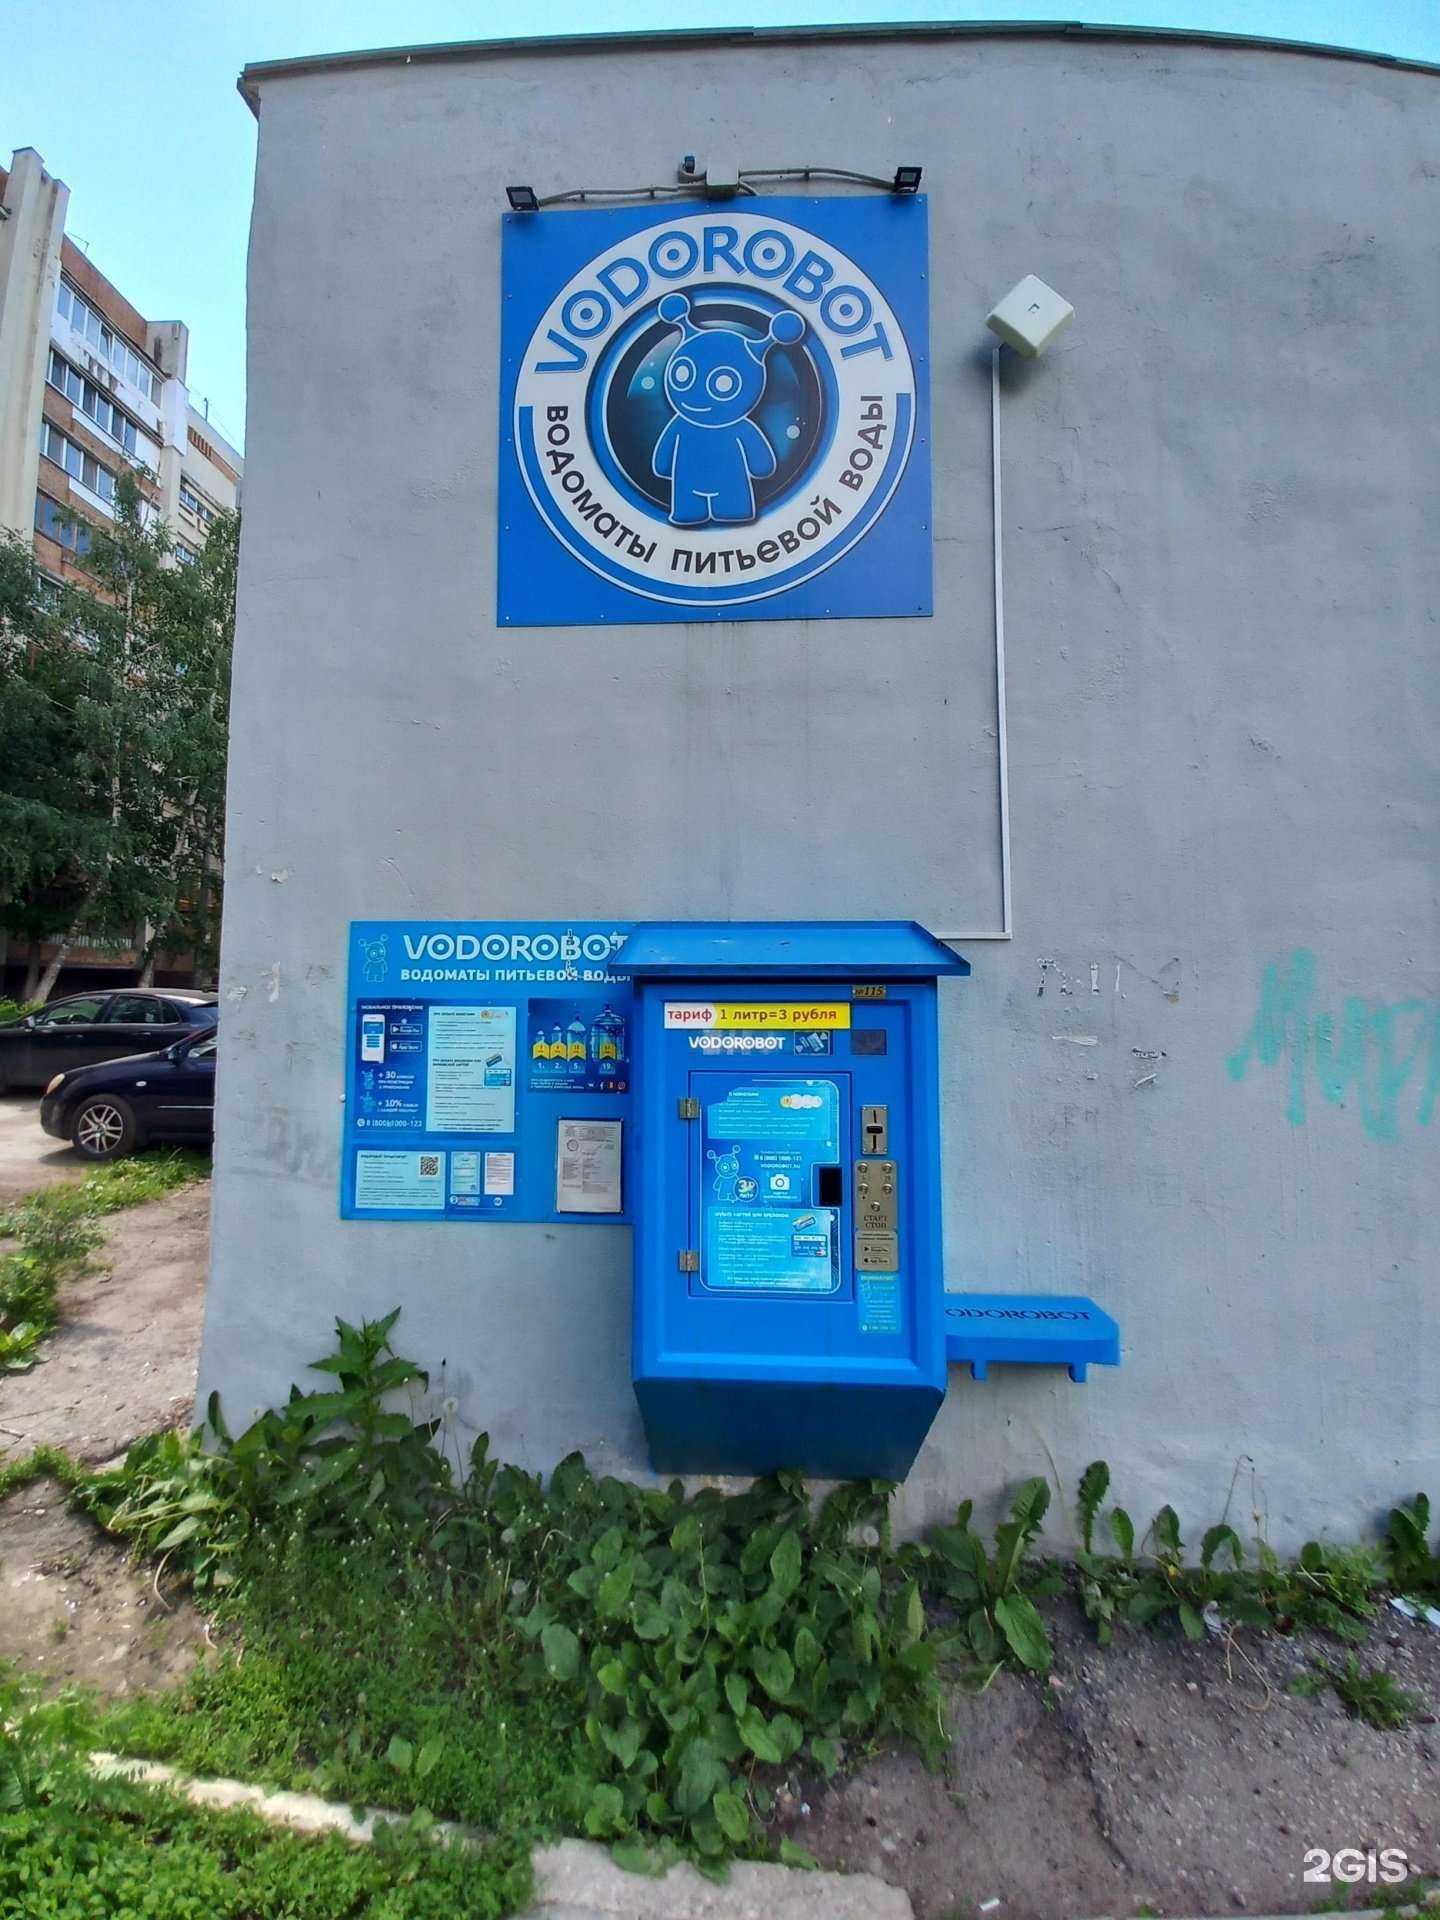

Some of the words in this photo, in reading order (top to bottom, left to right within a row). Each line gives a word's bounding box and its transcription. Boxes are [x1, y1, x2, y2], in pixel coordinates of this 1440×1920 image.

[534, 226, 895, 374] VODOROBOT
[403, 933, 629, 962] VODOROBOT
[401, 968, 490, 982] ВОДОМАТЫ
[668, 1009, 712, 1021] тариф
[720, 1009, 728, 1020] 1
[733, 1009, 788, 1023] литр=3
[793, 1008, 837, 1023] рубля
[688, 1036, 786, 1050] VODOROBOT
[944, 1309, 1090, 1320] ODOROBOT
